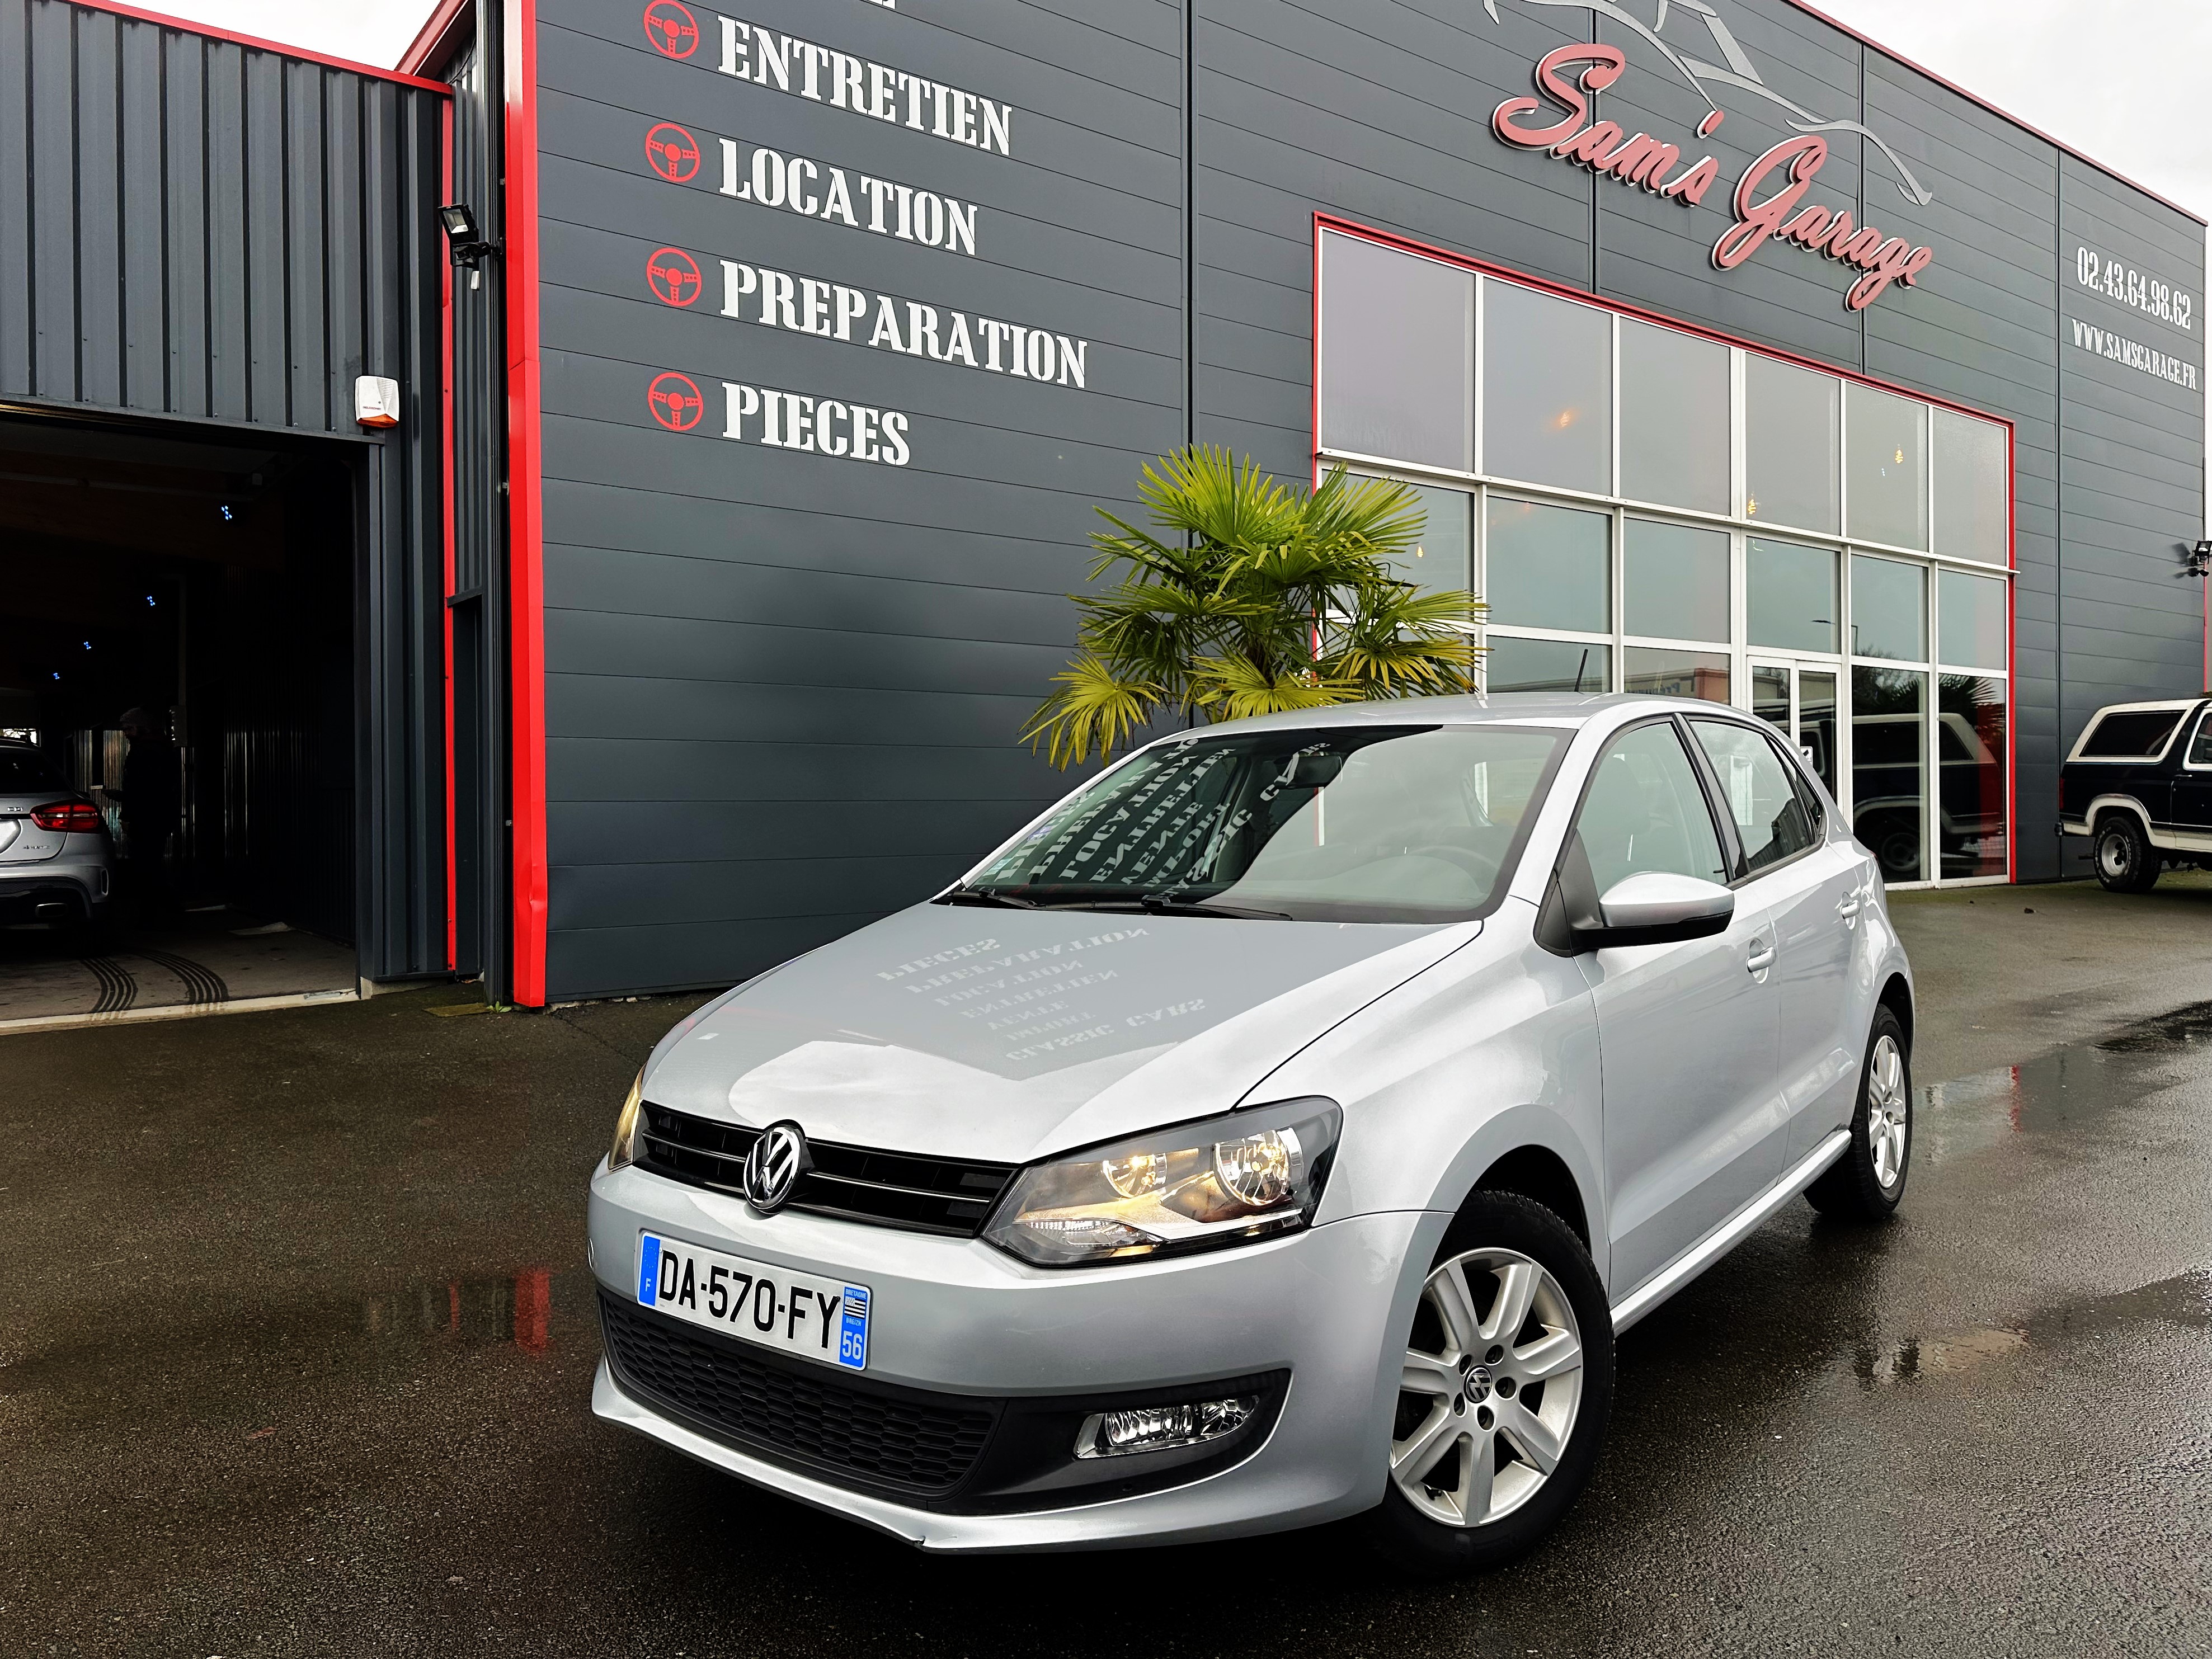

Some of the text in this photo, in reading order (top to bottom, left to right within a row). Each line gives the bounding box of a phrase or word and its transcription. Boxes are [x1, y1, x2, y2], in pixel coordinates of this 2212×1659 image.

[718, 15, 1013, 157] ENTRETIEN
[719, 137, 978, 256] LOCATION
[1493, 43, 1933, 313] Sam's Garage
[719, 259, 1088, 389] PREPARATION
[2077, 246, 2191, 330] 02.43.64.98.62
[722, 381, 910, 466] PIECES
[645, 1277, 652, 1292] F
[658, 1249, 841, 1349] DA-570-FY
[842, 1330, 863, 1360] 56
